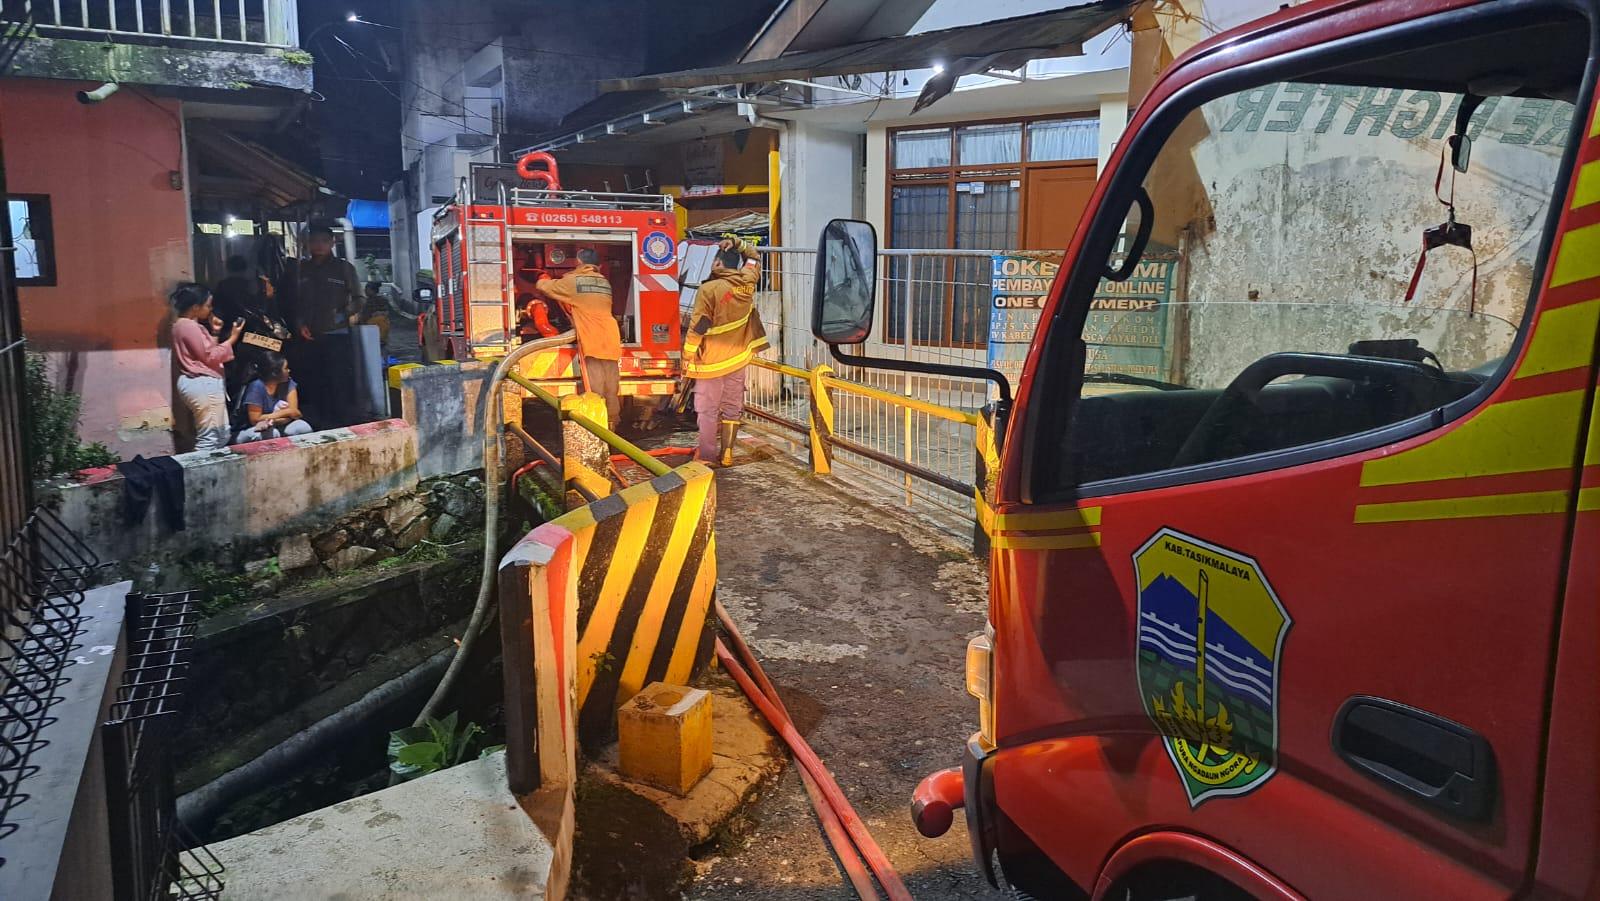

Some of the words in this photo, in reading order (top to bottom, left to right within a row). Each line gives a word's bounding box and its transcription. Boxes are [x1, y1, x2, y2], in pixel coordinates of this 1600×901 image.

[541, 213, 577, 224] (0265)
[581, 215, 622, 225] 548113
[993, 259, 1056, 276] LOKE
[1105, 281, 1165, 294] ONLINE
[995, 297, 1034, 307] ONE
